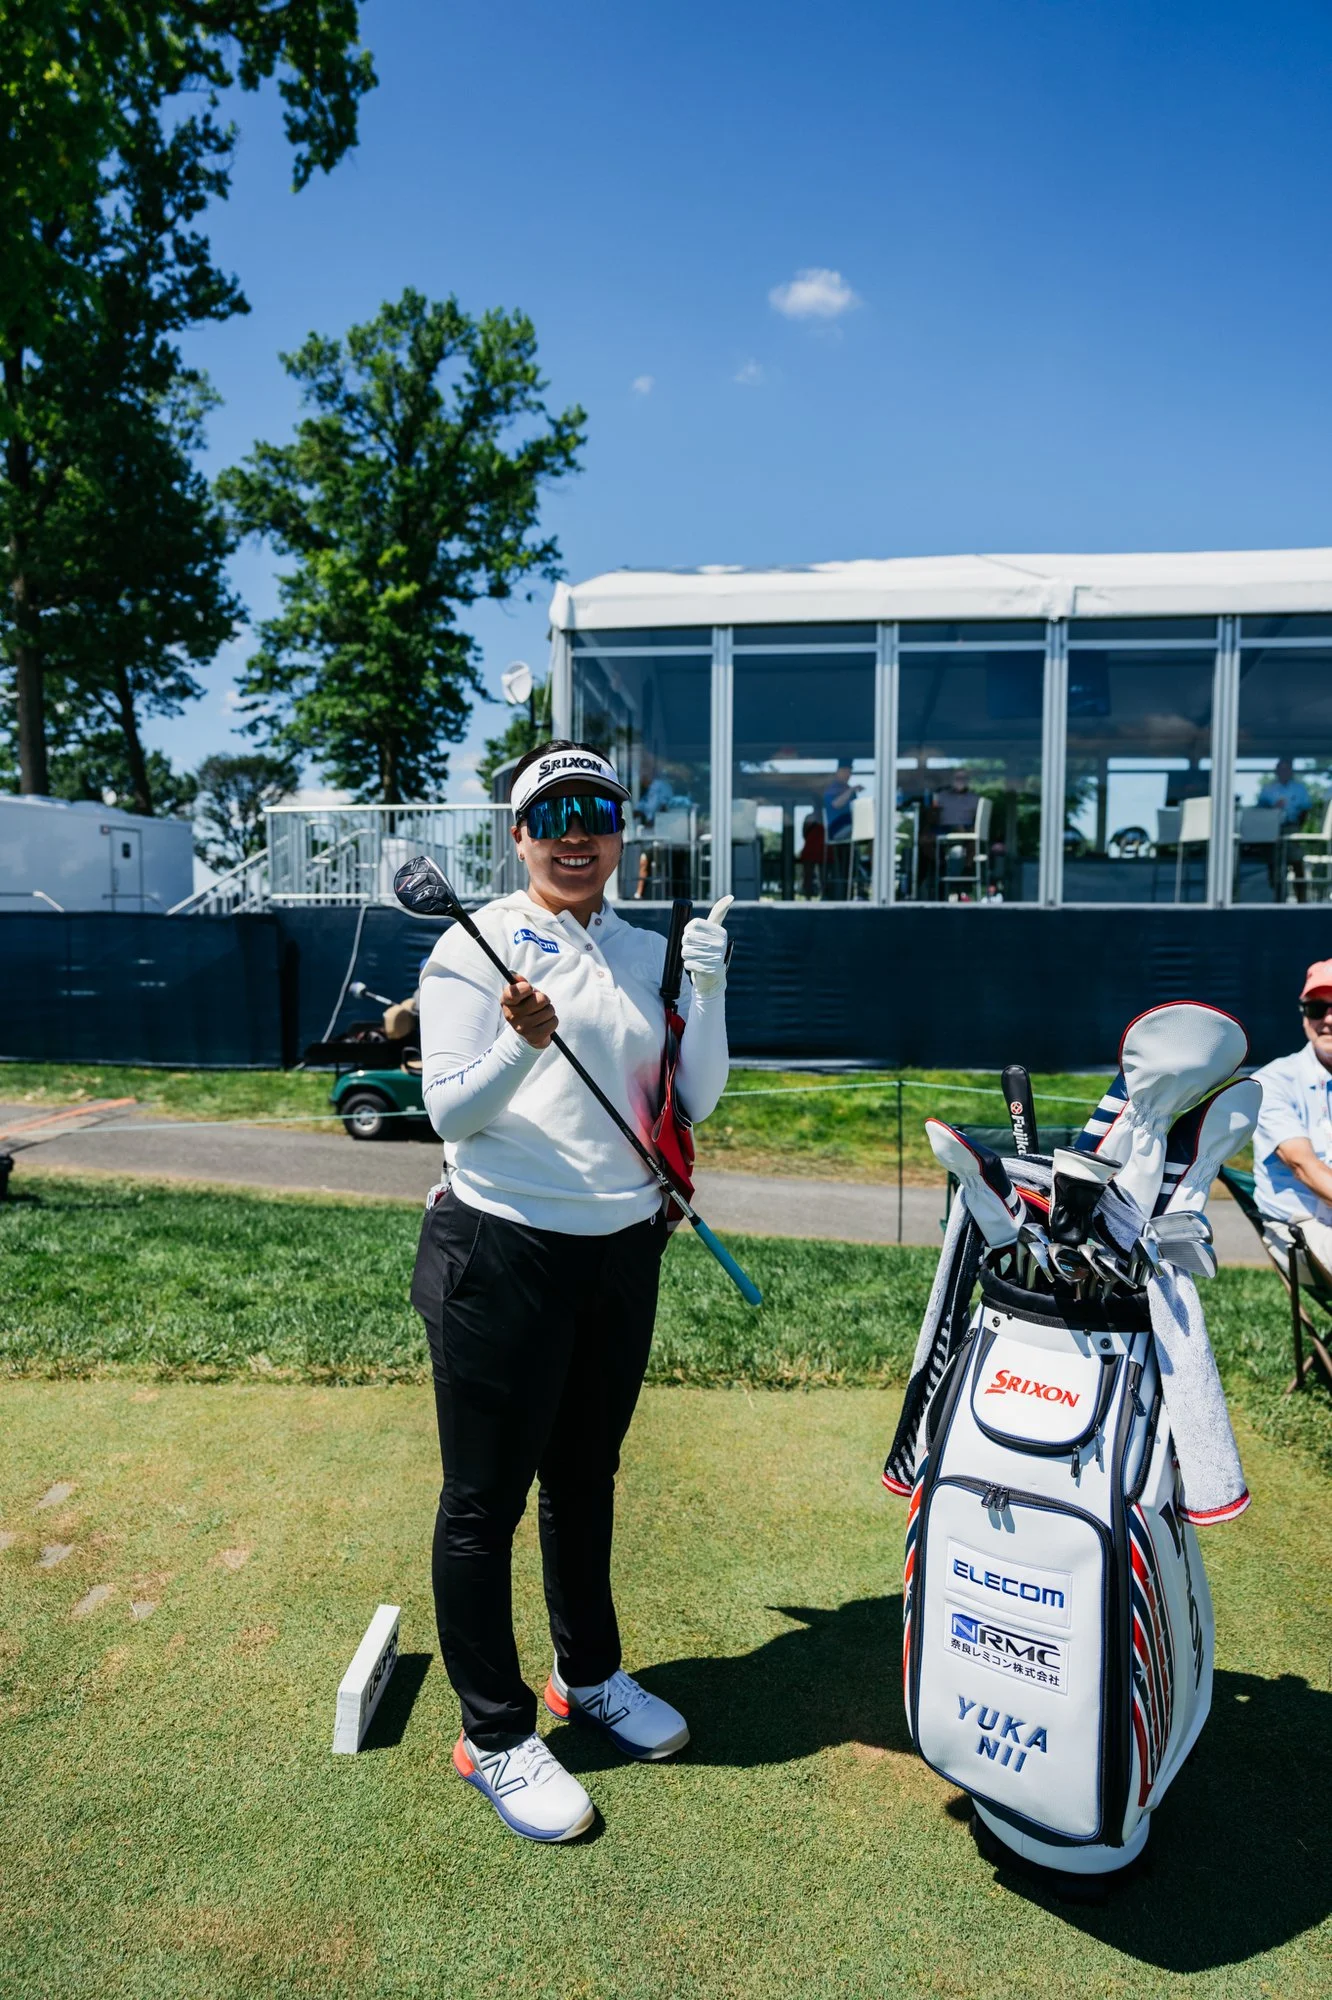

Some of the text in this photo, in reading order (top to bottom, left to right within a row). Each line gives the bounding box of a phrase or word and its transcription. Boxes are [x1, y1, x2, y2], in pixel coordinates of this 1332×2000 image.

[538, 757, 602, 783] SRIXON
[984, 1369, 1080, 1408] SRIXON
[953, 1558, 1065, 1608] ELECOM
[950, 1637, 1061, 1687] 奈良レミコン株式会社
[958, 1694, 1047, 1753] YUKA
[976, 1734, 1027, 1773] NII
